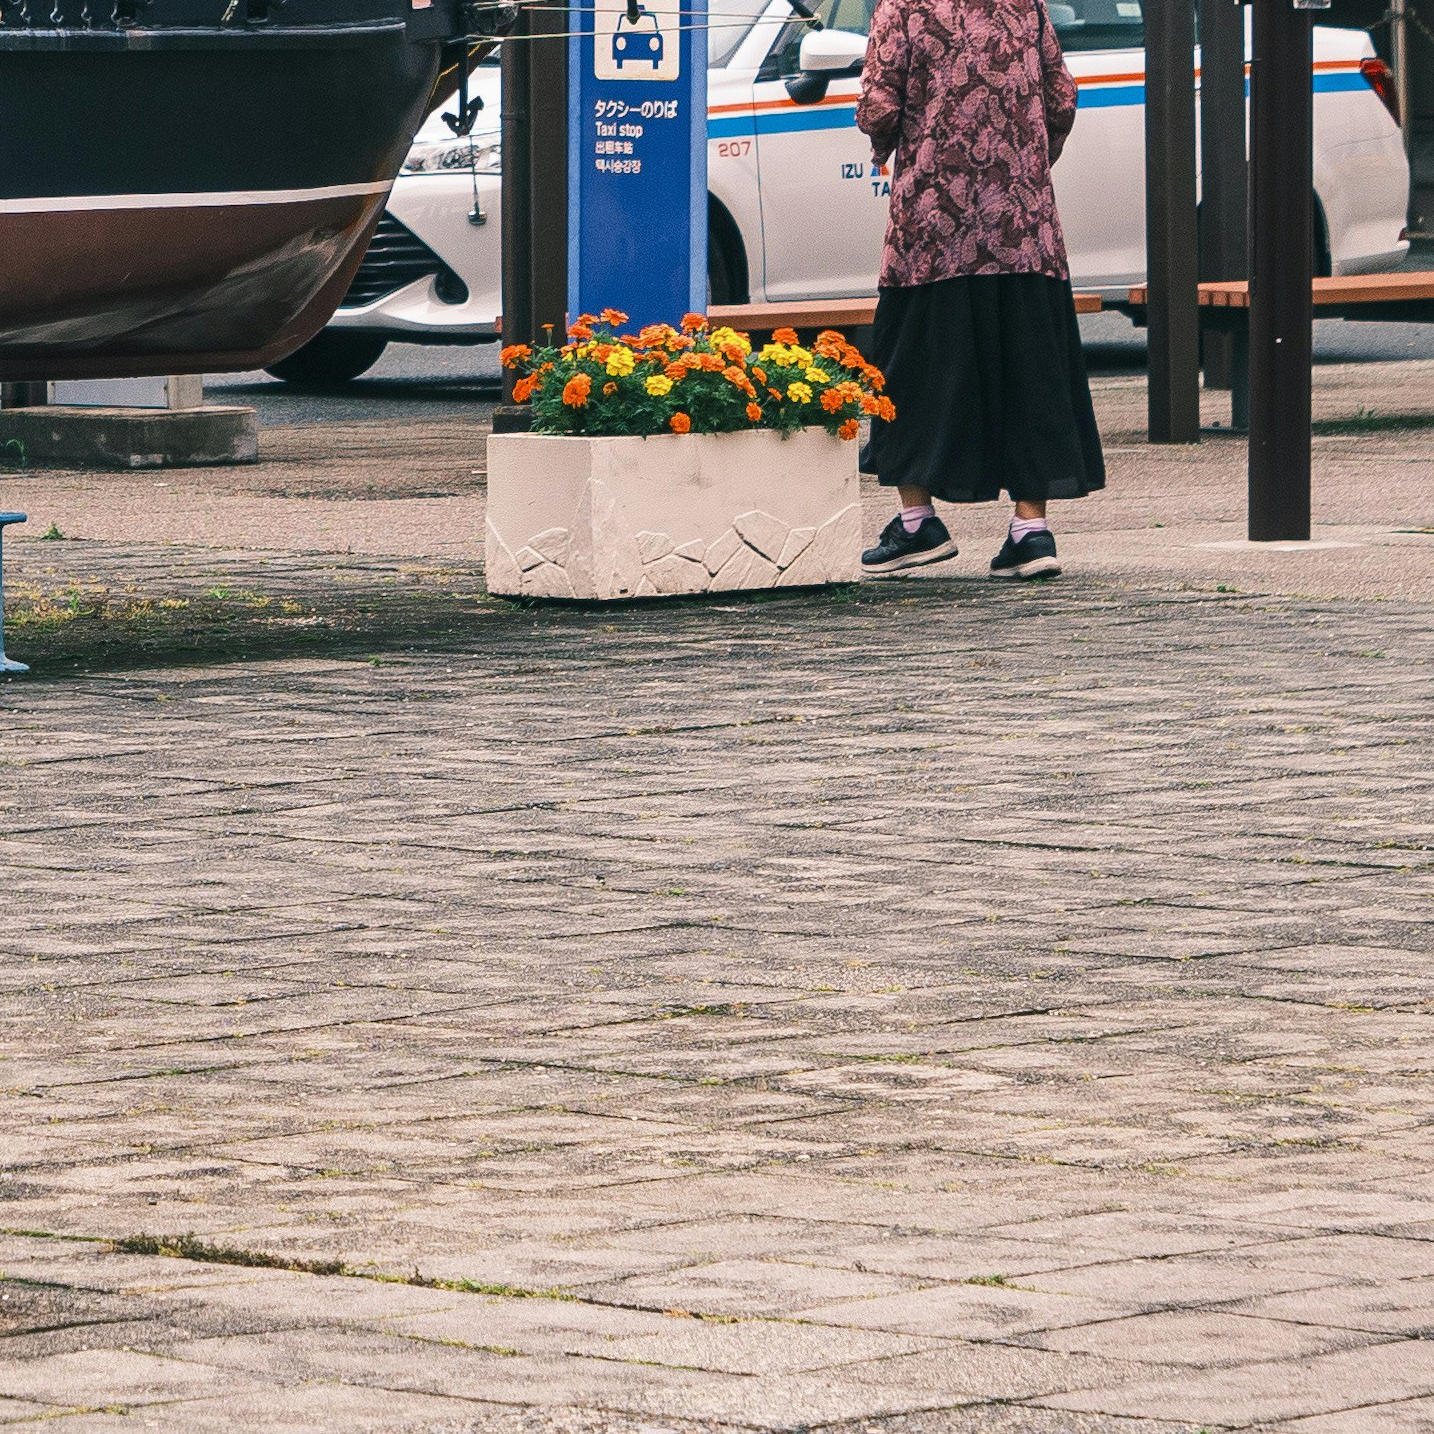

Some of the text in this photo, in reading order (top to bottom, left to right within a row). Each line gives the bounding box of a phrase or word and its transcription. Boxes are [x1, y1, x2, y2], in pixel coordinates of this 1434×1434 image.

[594, 99, 678, 118] タクシーのりば
[595, 121, 643, 139] Taxi stop
[718, 141, 751, 157] 207
[841, 163, 864, 179] IZU
